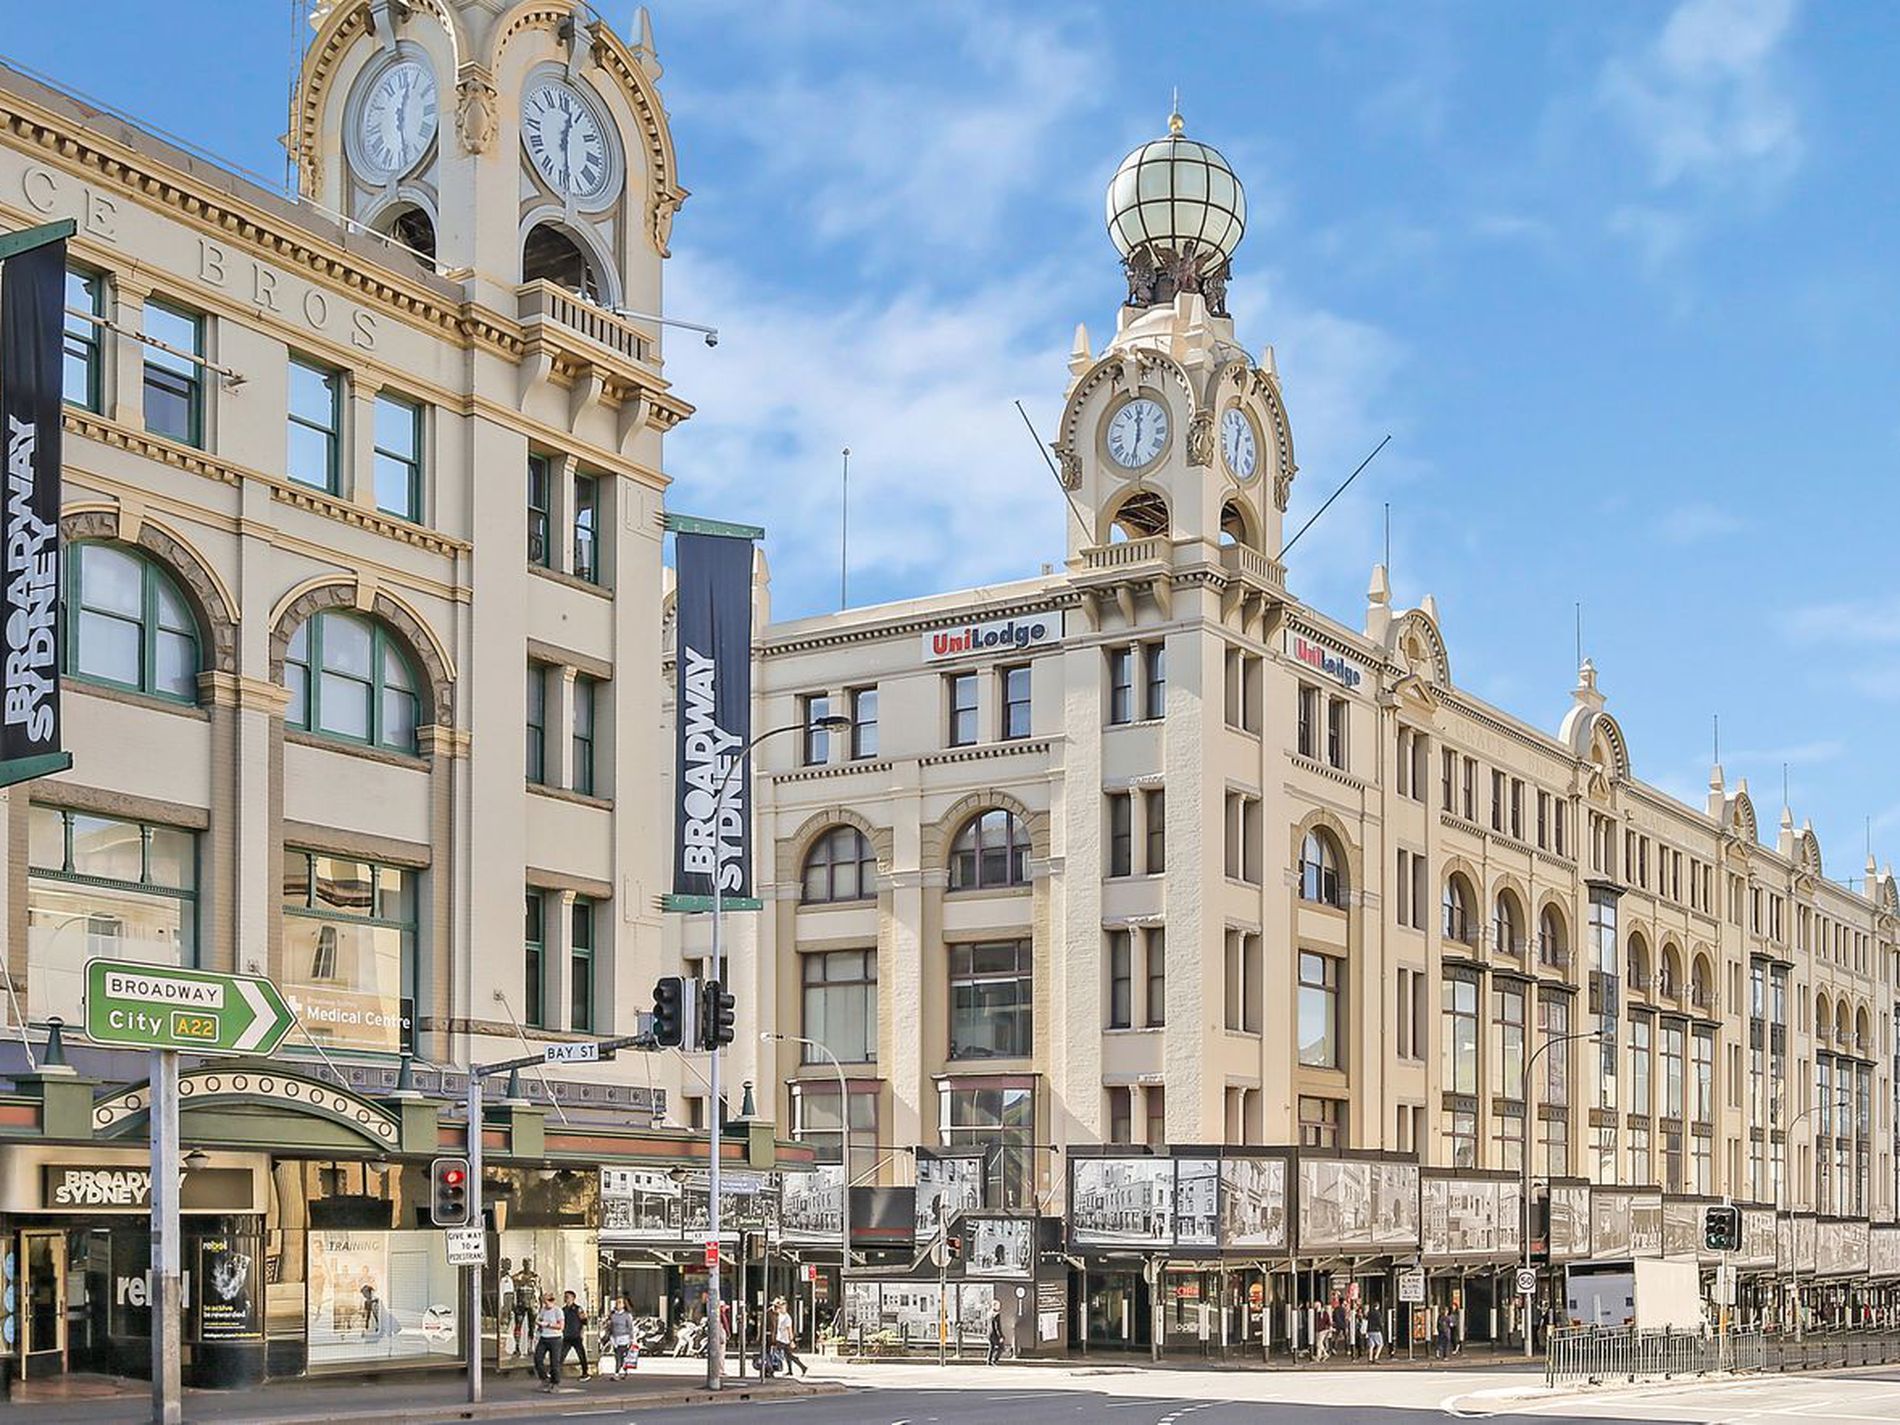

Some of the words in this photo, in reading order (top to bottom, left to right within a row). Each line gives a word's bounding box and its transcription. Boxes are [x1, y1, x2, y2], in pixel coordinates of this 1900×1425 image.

[198, 238, 378, 351] BROS
[4, 414, 36, 725] BROADWAY
[27, 520, 57, 743] SYDNEY
[932, 621, 1046, 655] UniLodge
[1295, 637, 1361, 687] UniLodge
[683, 646, 717, 874] BROADWAY
[712, 725, 743, 892] SYDNEY
[111, 978, 218, 1002] BROADWAY
[108, 1010, 163, 1036] City
[175, 1018, 214, 1036] A22
[306, 1005, 361, 1025] Medical
[365, 1011, 411, 1030] Centre
[547, 1046, 574, 1059] BAY
[580, 1045, 594, 1058] ST
[55, 1185, 150, 1204] SYDNEY
[326, 1240, 380, 1252] TRAINING
[117, 1268, 190, 1309] rel
[1520, 1276, 1532, 1286] 50
